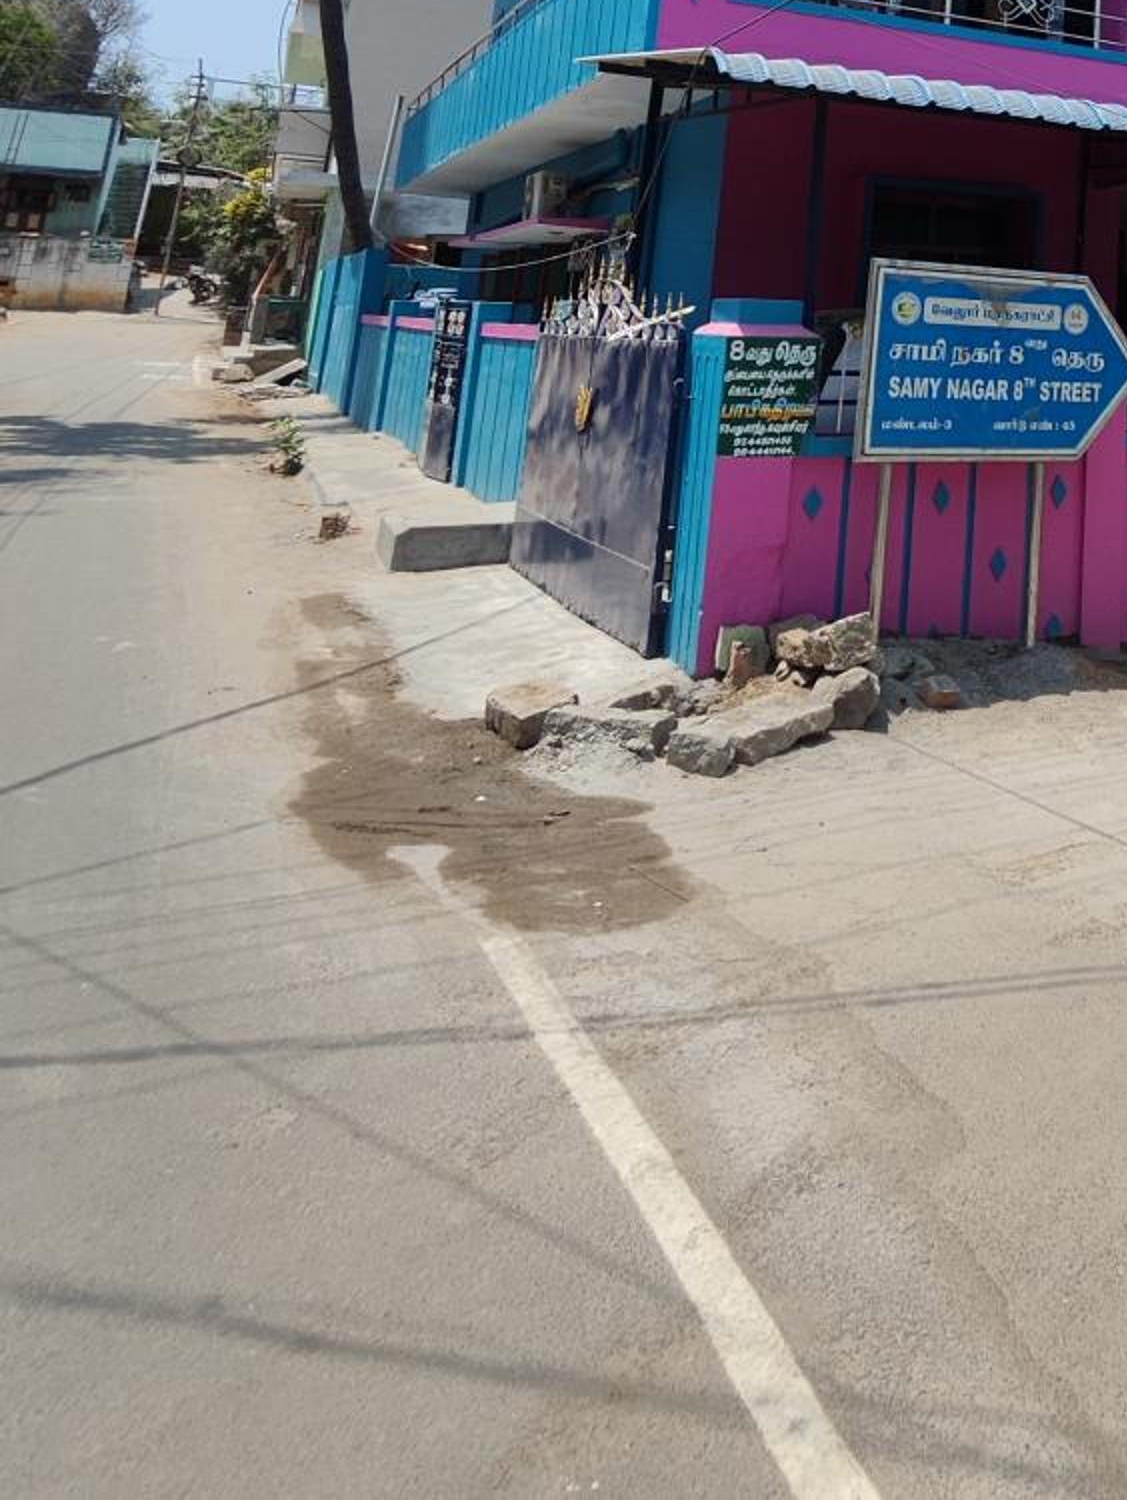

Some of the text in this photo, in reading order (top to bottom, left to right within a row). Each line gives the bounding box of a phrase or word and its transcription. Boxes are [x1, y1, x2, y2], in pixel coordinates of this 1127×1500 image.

[774, 340, 817, 367] தெரு
[889, 338, 947, 364] சாமி
[950, 340, 1004, 368] நகர்
[1051, 348, 1105, 373] தெரு
[888, 376, 946, 400] SAMY
[946, 378, 1009, 401] NAGAR
[1039, 381, 1102, 403] STREET
